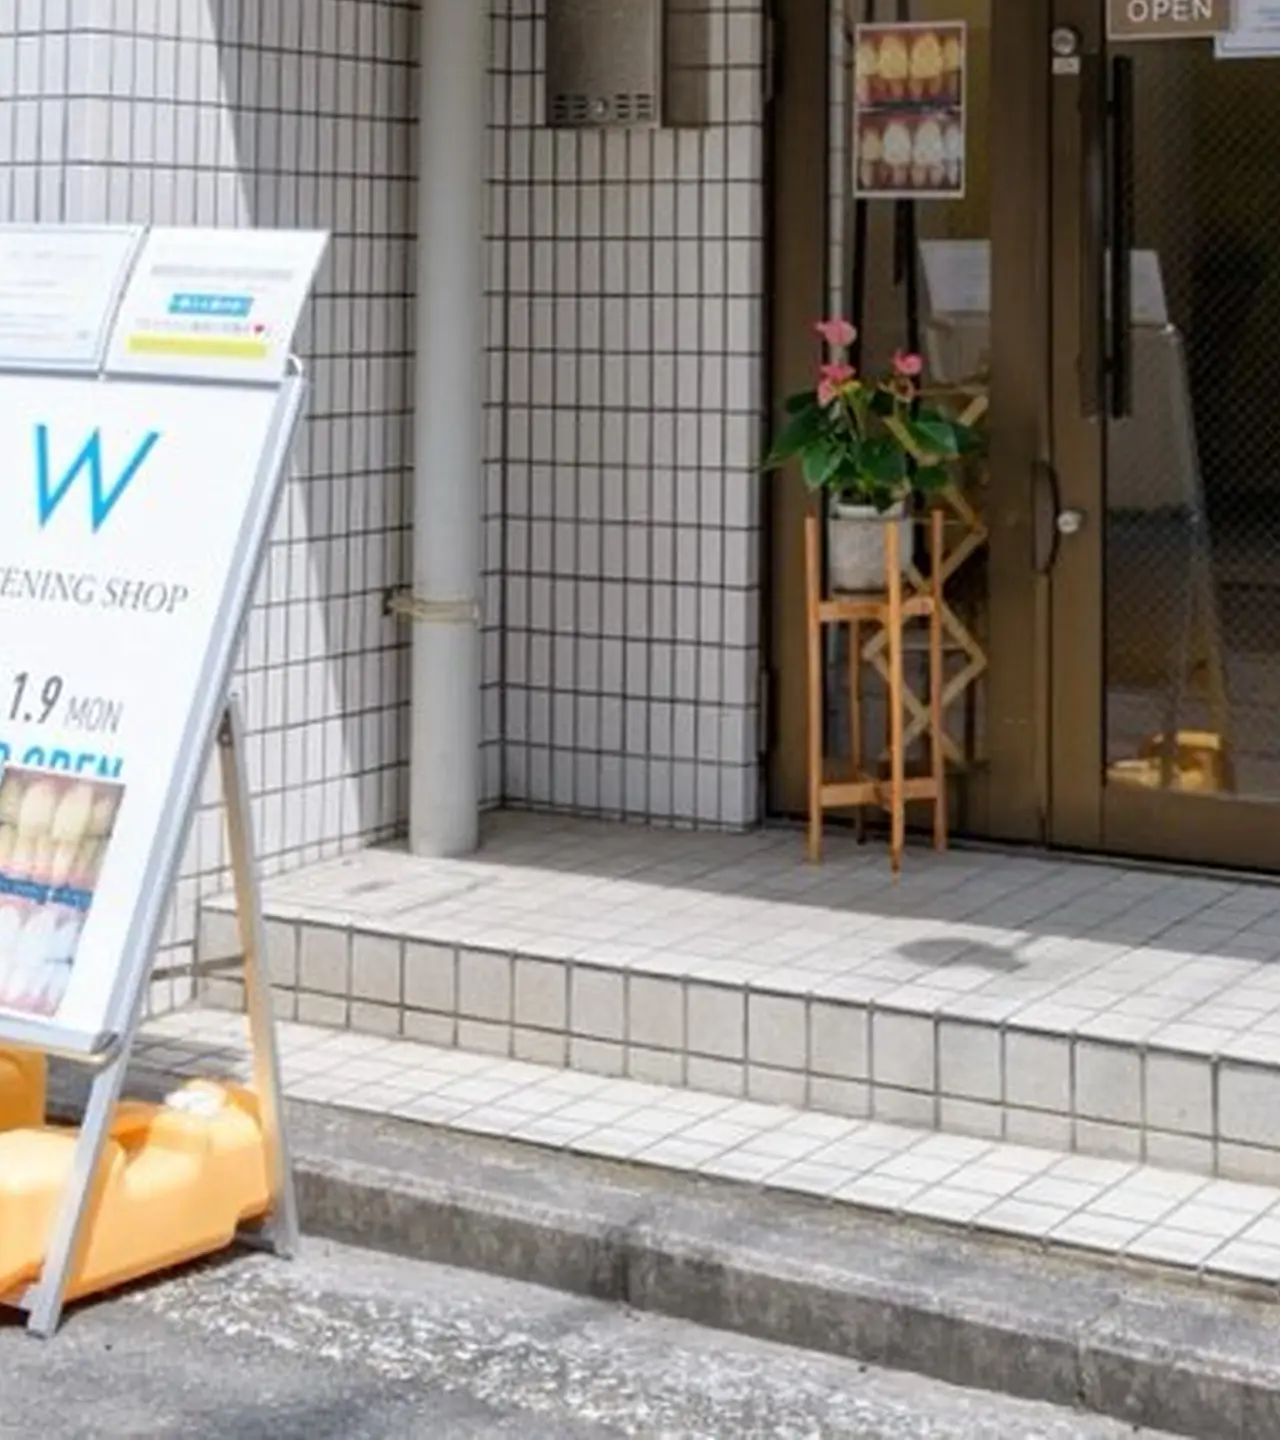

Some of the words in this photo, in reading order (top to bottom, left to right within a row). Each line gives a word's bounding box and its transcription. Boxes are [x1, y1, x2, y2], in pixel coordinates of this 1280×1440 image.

[32, 422, 161, 533] W
[101, 575, 190, 615] SHOP
[64, 696, 124, 734] MON
